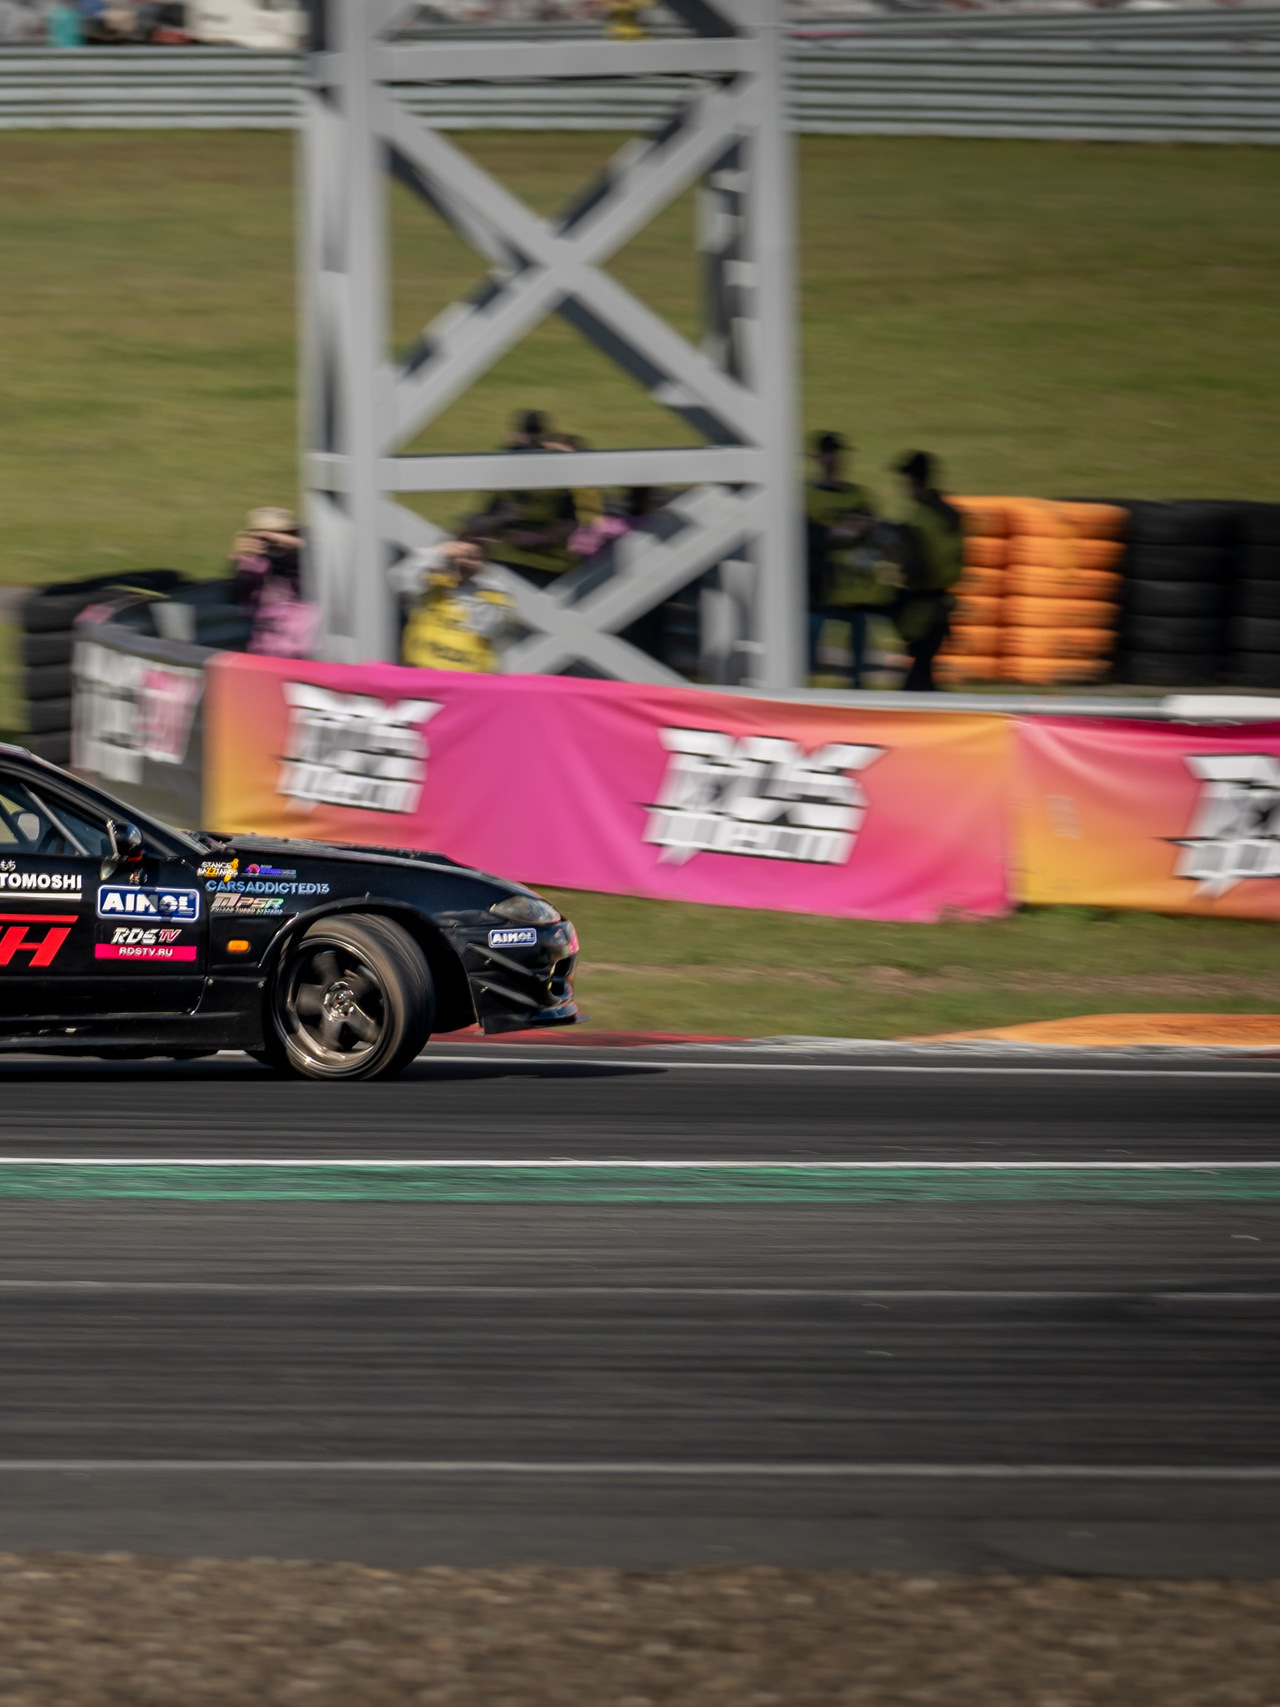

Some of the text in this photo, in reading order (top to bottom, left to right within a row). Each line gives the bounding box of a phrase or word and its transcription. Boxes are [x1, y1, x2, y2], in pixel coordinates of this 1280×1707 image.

[205, 880, 330, 894] CARSADDICTED13
[101, 892, 195, 915] AIMOL
[118, 946, 174, 958] RDSTV.RU
